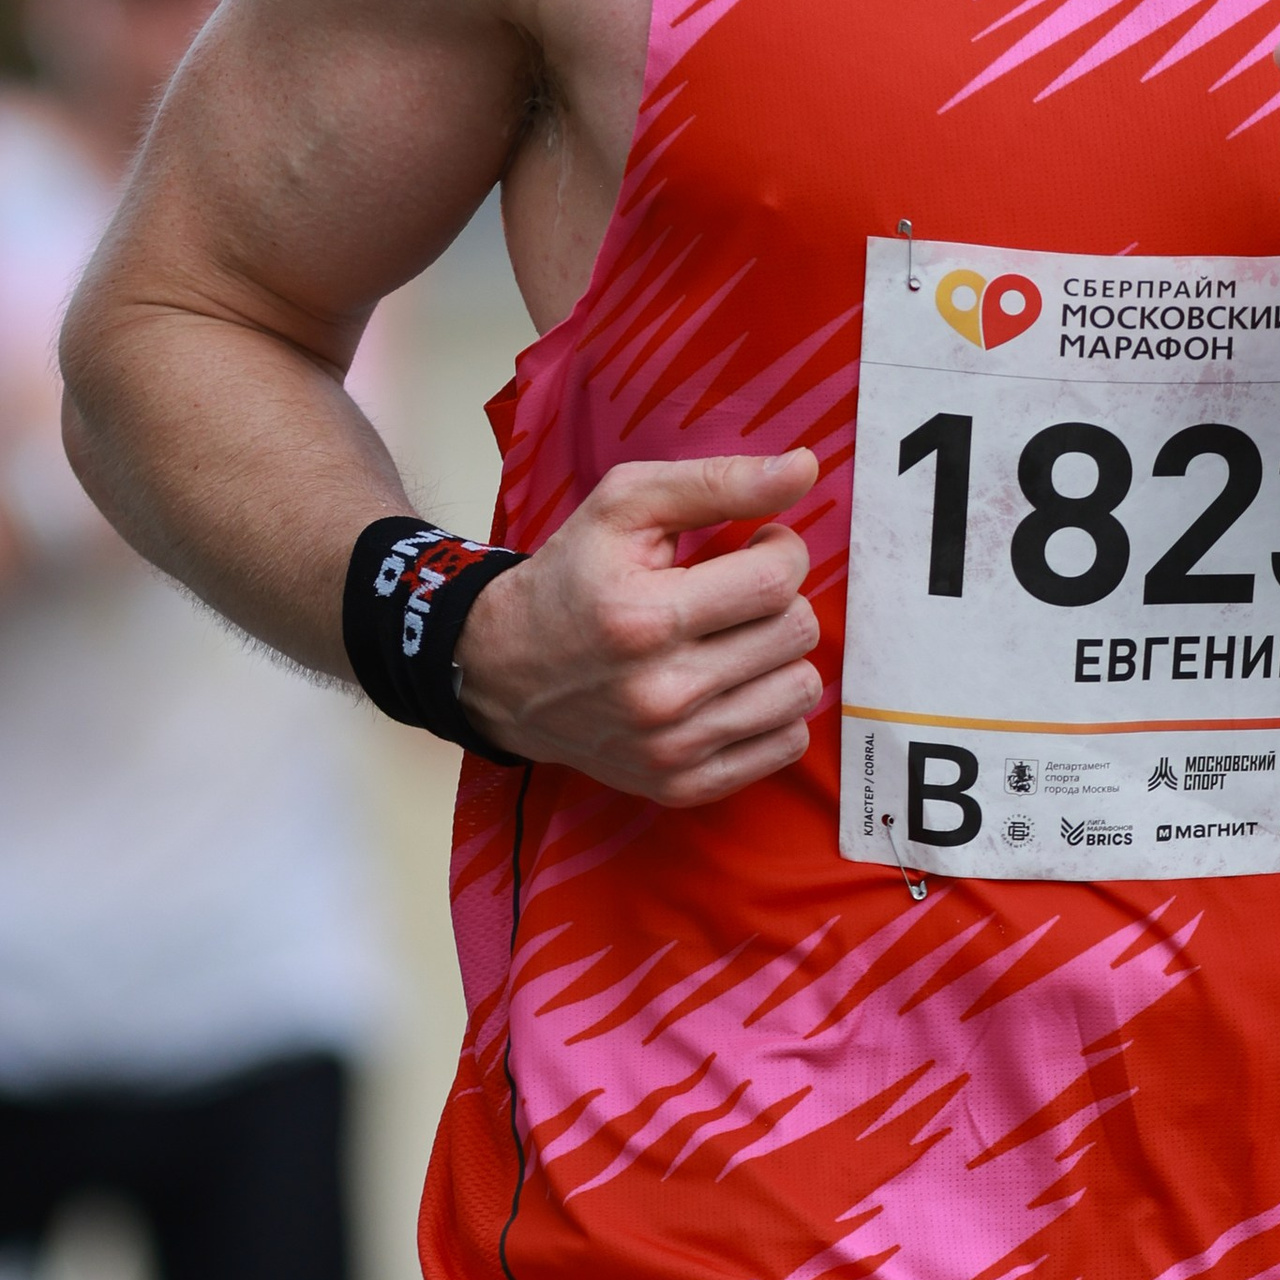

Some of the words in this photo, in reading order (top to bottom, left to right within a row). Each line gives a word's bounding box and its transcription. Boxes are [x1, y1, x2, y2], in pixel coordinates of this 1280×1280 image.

[1063, 276, 1237, 299] СБЕРПРАЙМ
[1059, 334, 1234, 360] МАРАФОН
[864, 733, 875, 776] CORRAL
[1185, 751, 1276, 772] МОСКОВСКИЙ
[1045, 762, 1111, 772] Департамент
[1045, 774, 1080, 783] спорта
[1184, 773, 1227, 790] СПОРТ
[1045, 786, 1079, 795] города
[1082, 785, 1119, 793] Москвы
[864, 785, 874, 836] КЛАСТЕР
[1086, 833, 1133, 846] BRICS
